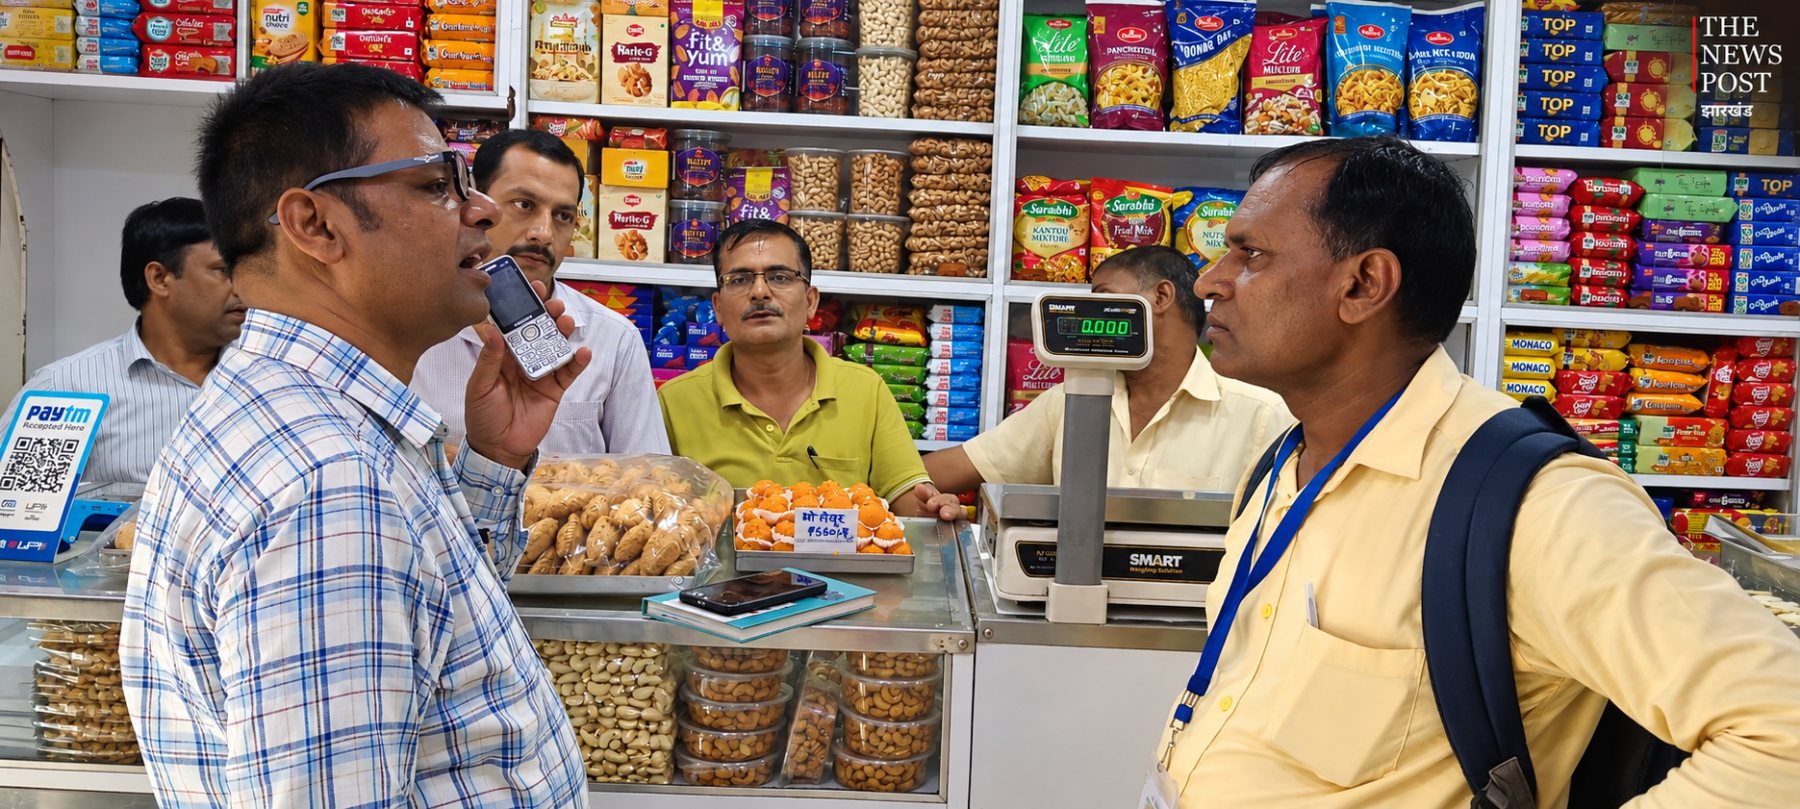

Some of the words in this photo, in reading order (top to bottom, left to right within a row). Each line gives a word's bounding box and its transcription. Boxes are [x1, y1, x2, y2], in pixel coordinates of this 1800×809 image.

[1543, 18, 1576, 31] TOP
[1543, 44, 1576, 57] TOP
[687, 50, 728, 67] yum
[1542, 70, 1576, 83] TOP
[1540, 97, 1574, 110] TOP
[1537, 125, 1571, 138] TOP
[1761, 179, 1793, 191] TOP
[1081, 319, 1129, 335] 0.000
[1511, 339, 1552, 350] MONACO
[1511, 362, 1551, 373] MONACO
[1506, 383, 1546, 394] MONACO
[1129, 554, 1183, 568] SMART
